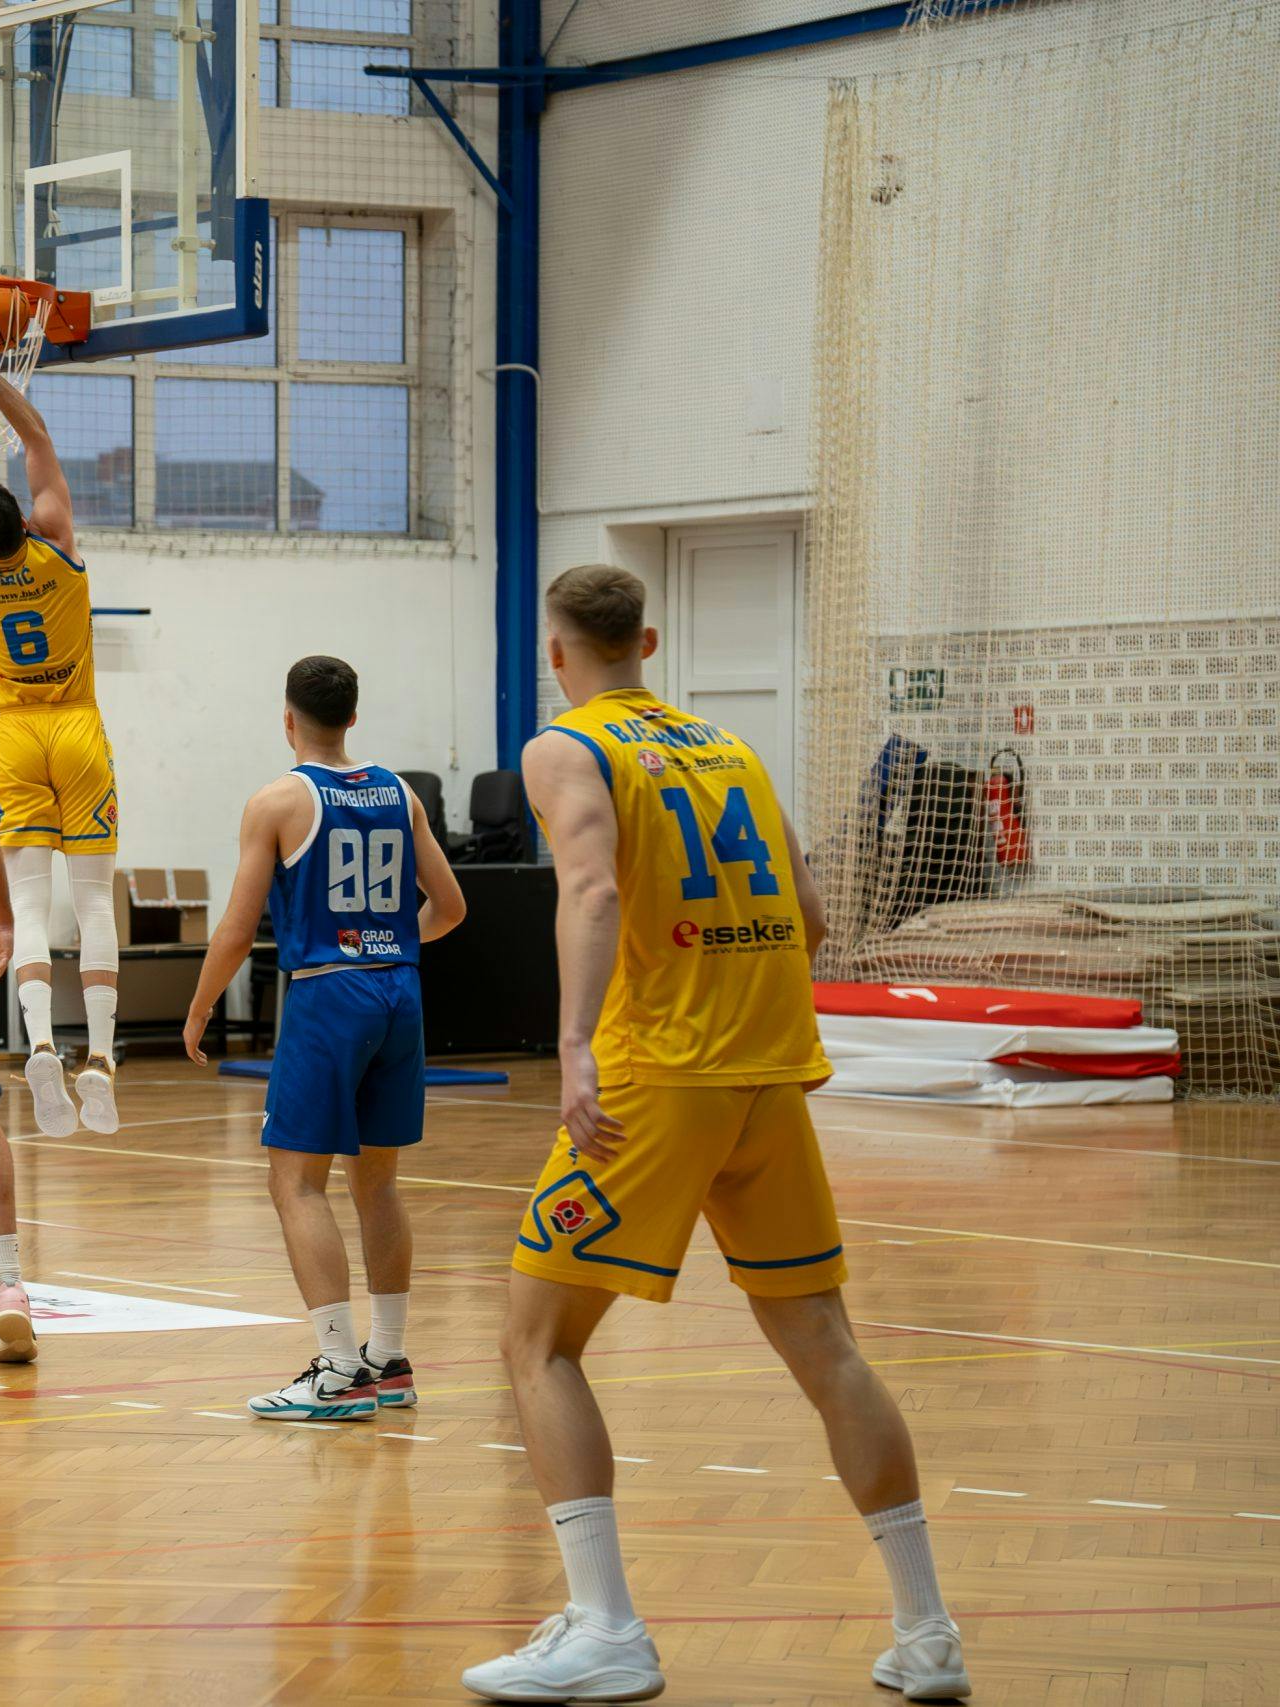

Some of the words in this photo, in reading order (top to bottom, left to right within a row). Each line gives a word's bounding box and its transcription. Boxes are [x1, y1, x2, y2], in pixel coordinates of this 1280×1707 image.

[1, 610, 50, 666] 6
[9, 663, 76, 685] seker
[320, 786, 401, 808] TORBARINA
[660, 786, 781, 901] 14
[328, 828, 404, 913] 99
[361, 930, 395, 943] GRAD
[672, 918, 796, 949] esseker
[366, 943, 402, 956] ZADAR
